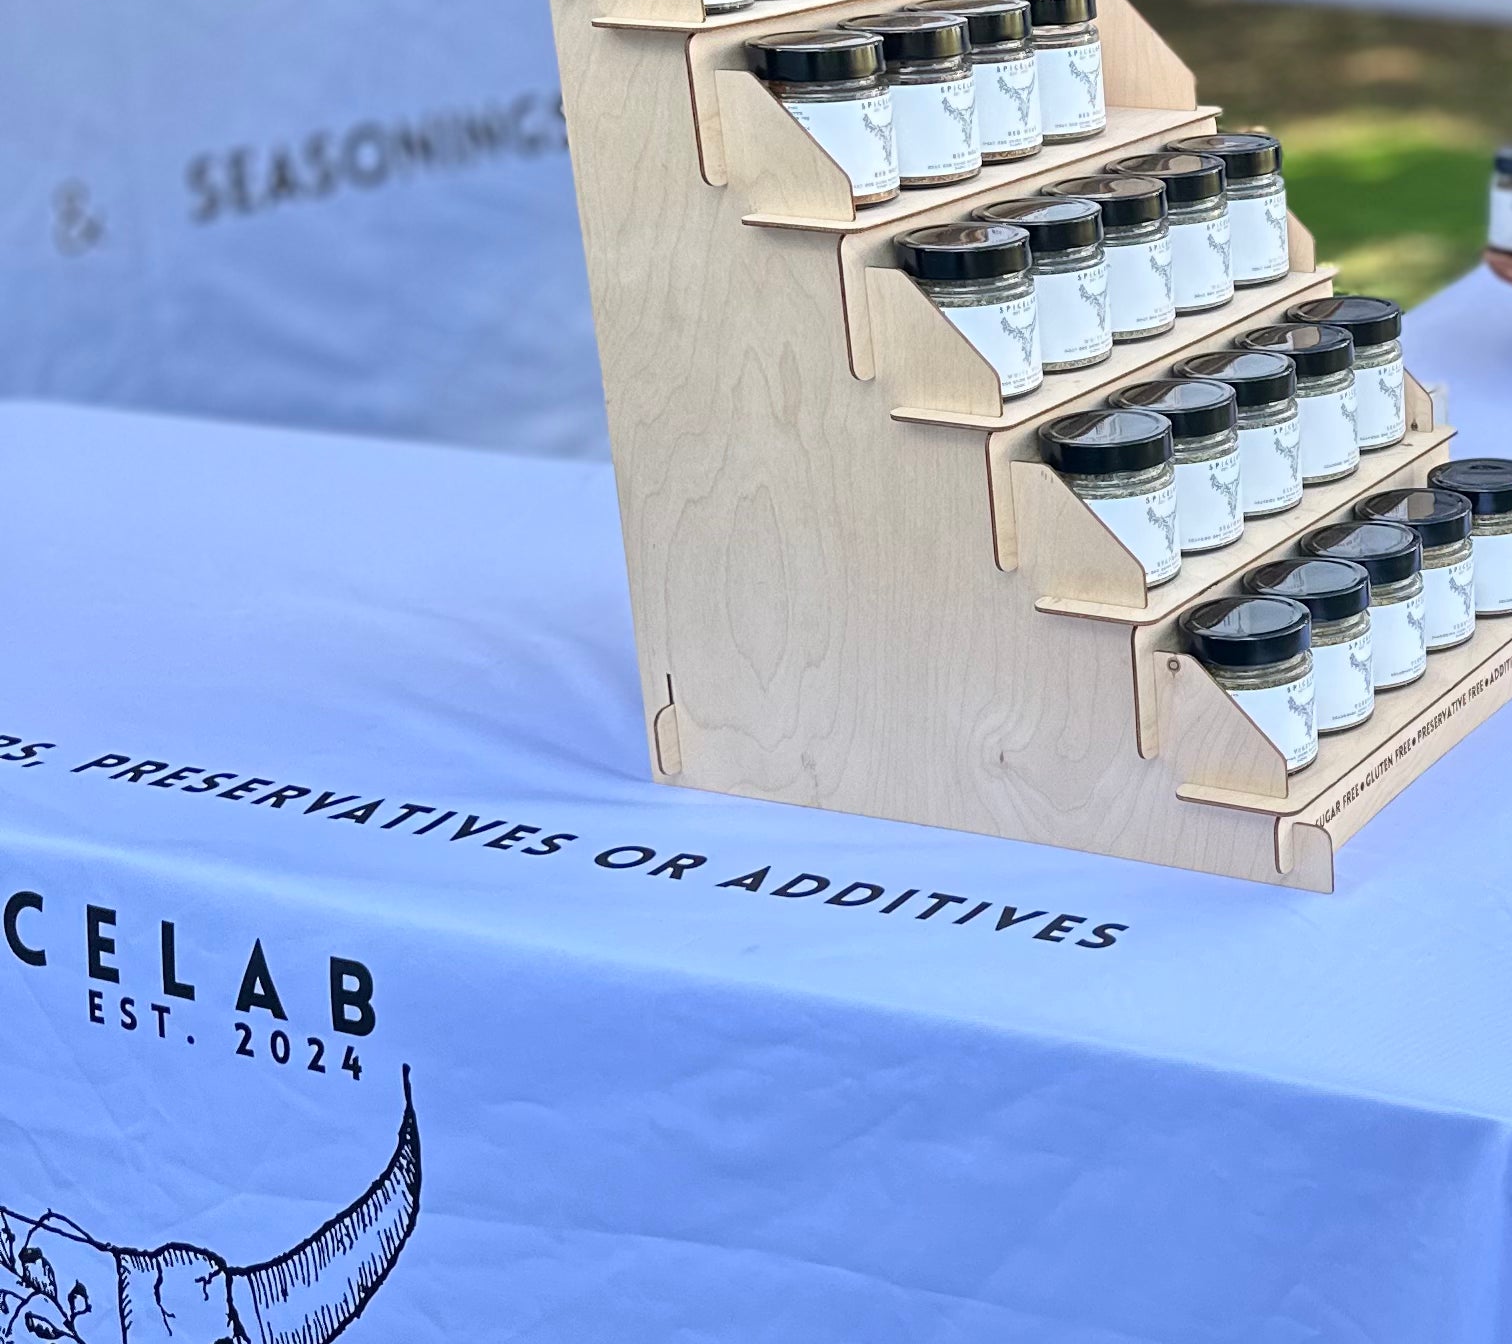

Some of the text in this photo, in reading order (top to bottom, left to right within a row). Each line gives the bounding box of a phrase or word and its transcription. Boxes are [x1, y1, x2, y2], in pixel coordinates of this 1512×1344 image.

[50, 177, 108, 257] &
[1342, 783, 1360, 809] FREE
[1365, 753, 1394, 787] GLUTEN
[1394, 738, 1412, 763] FREE
[1417, 692, 1467, 743] PRESERVATIVE
[1468, 678, 1484, 703] FREE
[69, 753, 579, 856] PRESERVATIVES
[593, 844, 709, 881] OR
[714, 864, 1130, 949] ADDITIVES
[3, 890, 377, 1038] CELAB
[87, 989, 363, 1082] EST. 2024
